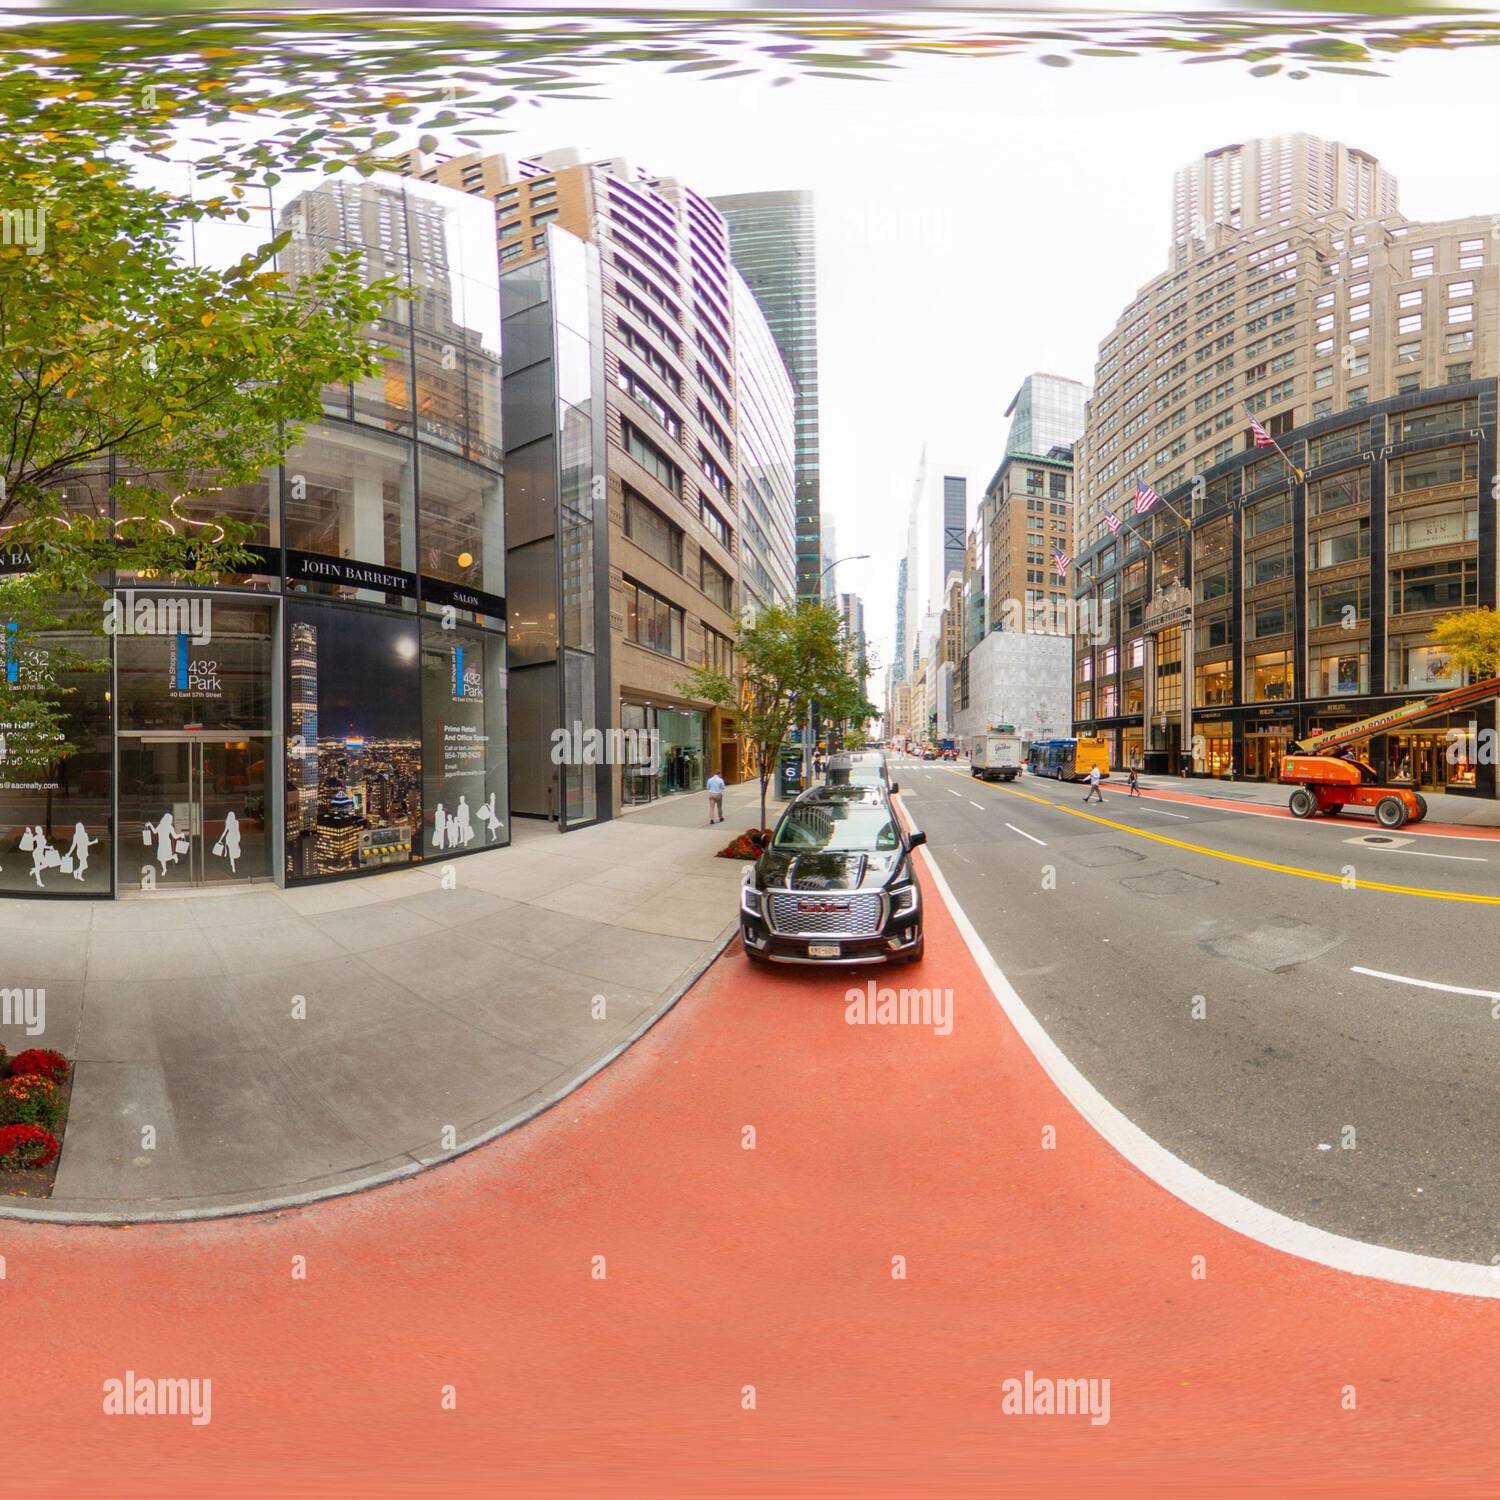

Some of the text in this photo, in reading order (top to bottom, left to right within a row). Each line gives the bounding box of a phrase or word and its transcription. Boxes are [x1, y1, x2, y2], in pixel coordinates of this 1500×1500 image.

[301, 559, 408, 589] JOHN BARRETT
[453, 591, 479, 606] SALON
[188, 660, 217, 675] 432
[188, 675, 222, 690] Park
[463, 673, 481, 686] 432
[463, 685, 483, 697] Park
[444, 725, 476, 733] Prime Retail
[785, 767, 796, 777] 6
